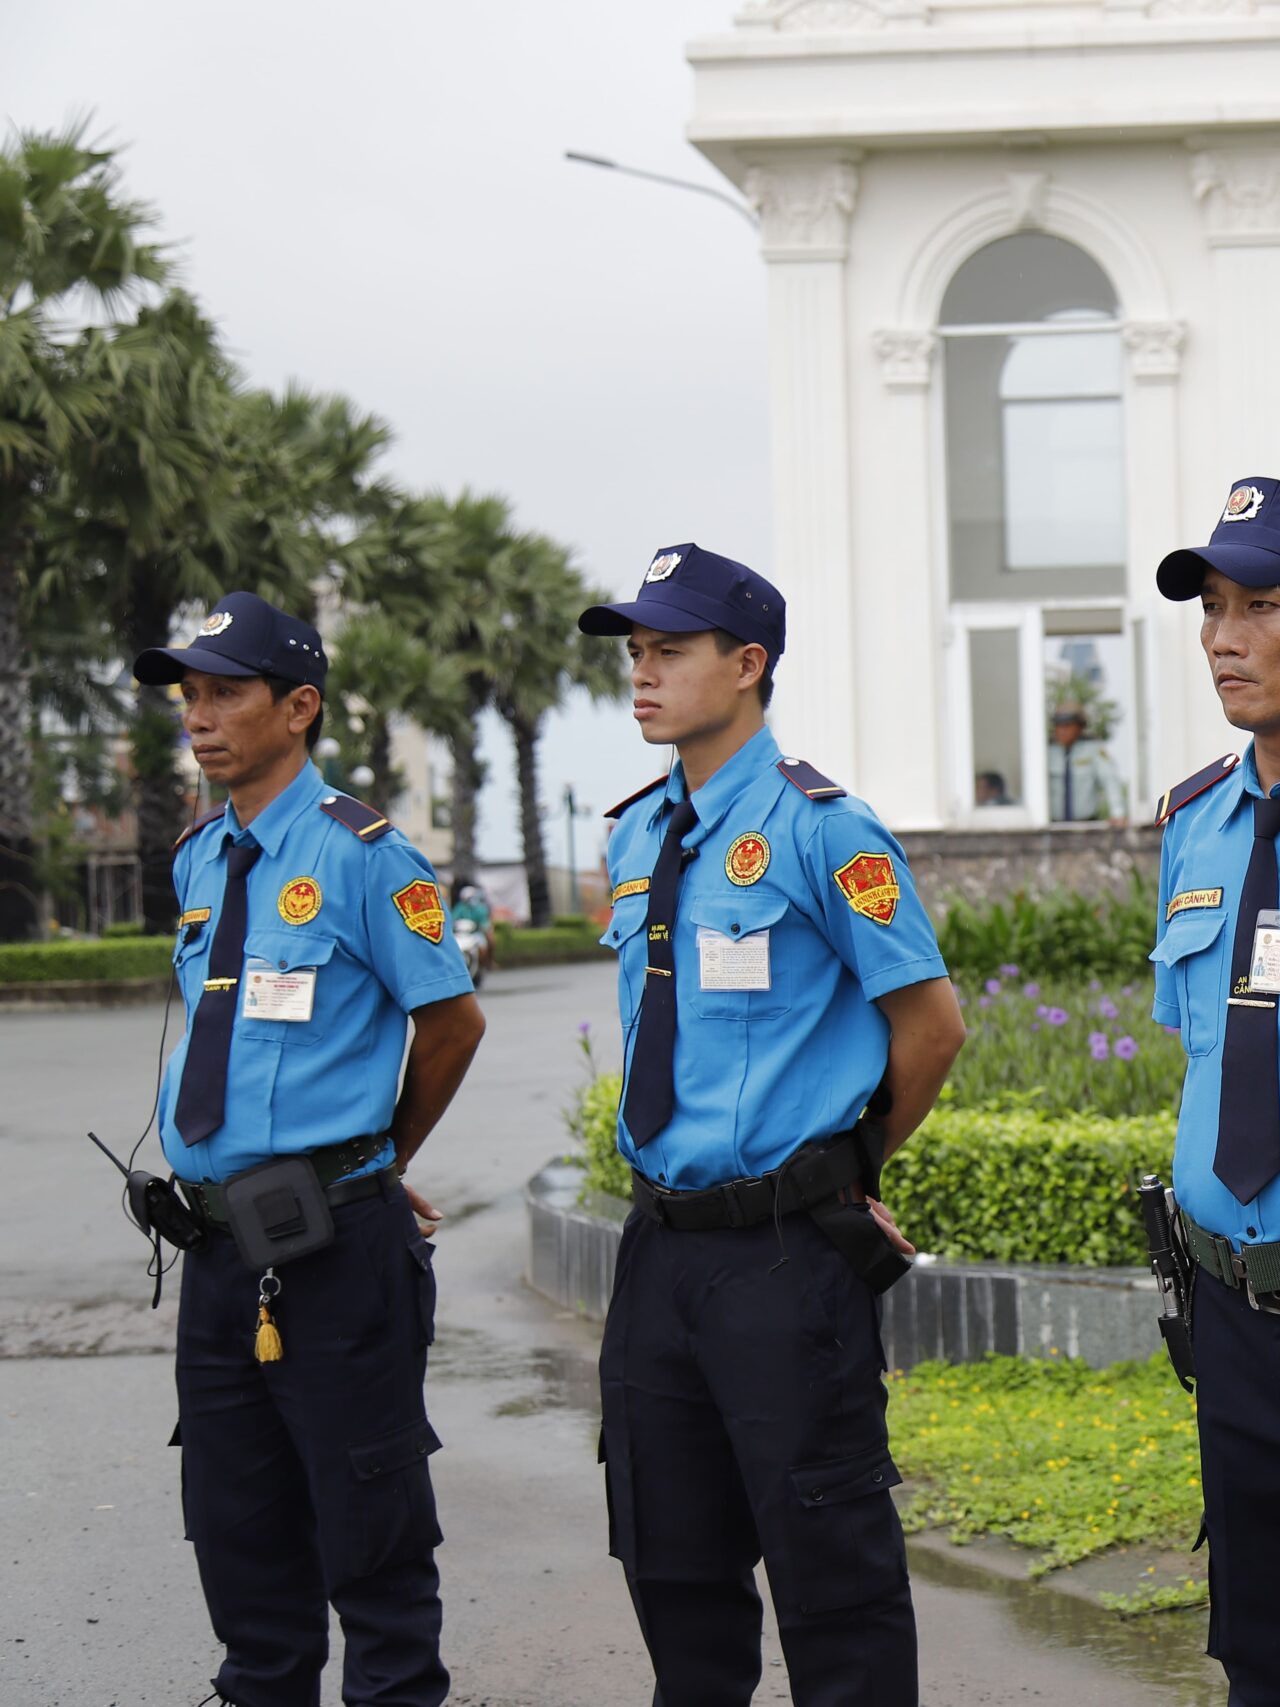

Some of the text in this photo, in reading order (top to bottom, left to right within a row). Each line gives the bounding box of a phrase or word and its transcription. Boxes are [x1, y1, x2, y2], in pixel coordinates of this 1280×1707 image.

[1184, 892, 1205, 905] CẢNH
[1238, 975, 1248, 984] AN
[1233, 983, 1252, 994] CẢN
